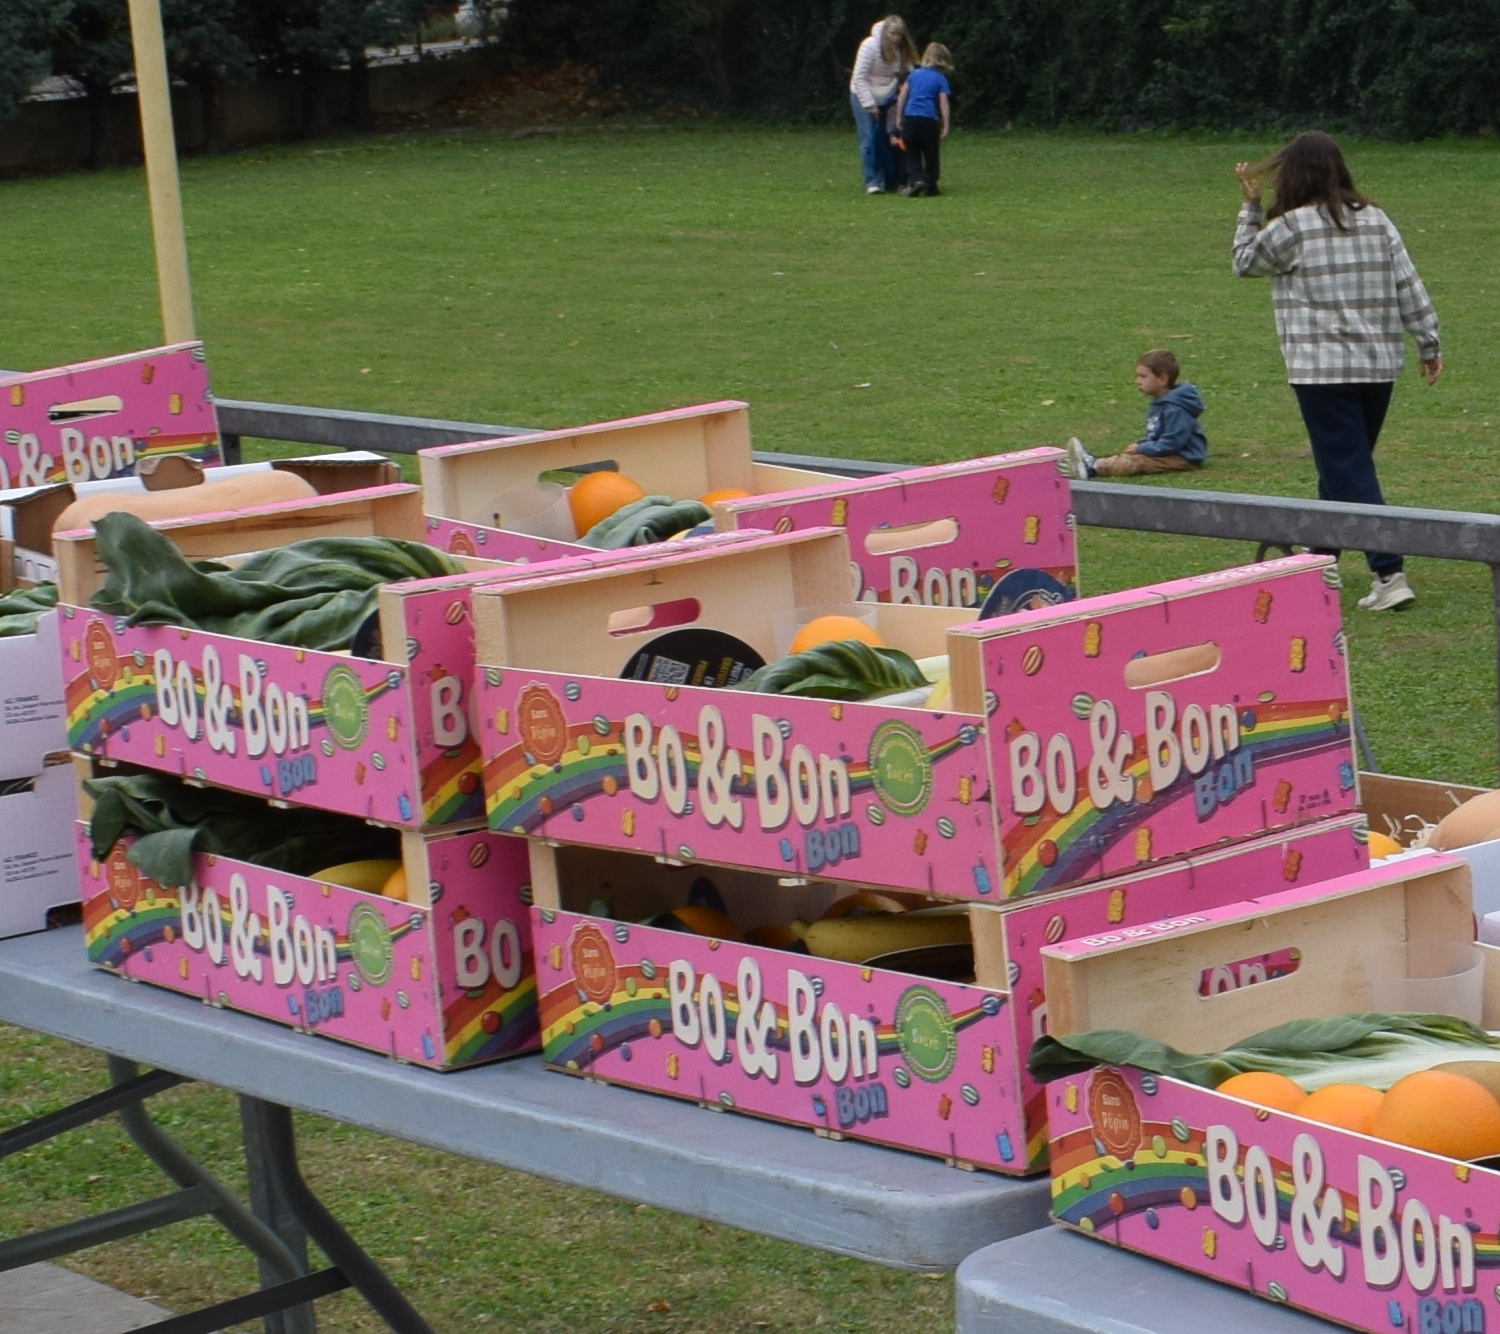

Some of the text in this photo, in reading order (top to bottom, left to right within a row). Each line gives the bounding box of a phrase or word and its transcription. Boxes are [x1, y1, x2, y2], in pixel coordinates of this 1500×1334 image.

[203, 643, 237, 755] &
[238, 653, 311, 757] Bon
[1089, 699, 1135, 809] &
[1145, 691, 1241, 792] Bon
[698, 704, 743, 829] &
[752, 713, 852, 830] Bon
[1193, 749, 1255, 822] Bon
[805, 821, 861, 873] Bon
[230, 872, 263, 982] &
[266, 884, 337, 986] Bon
[735, 956, 779, 1080] &
[788, 969, 878, 1083] Bon
[835, 1083, 888, 1128] Bon
[1291, 1133, 1346, 1278] &
[1358, 1154, 1476, 1292] Bon
